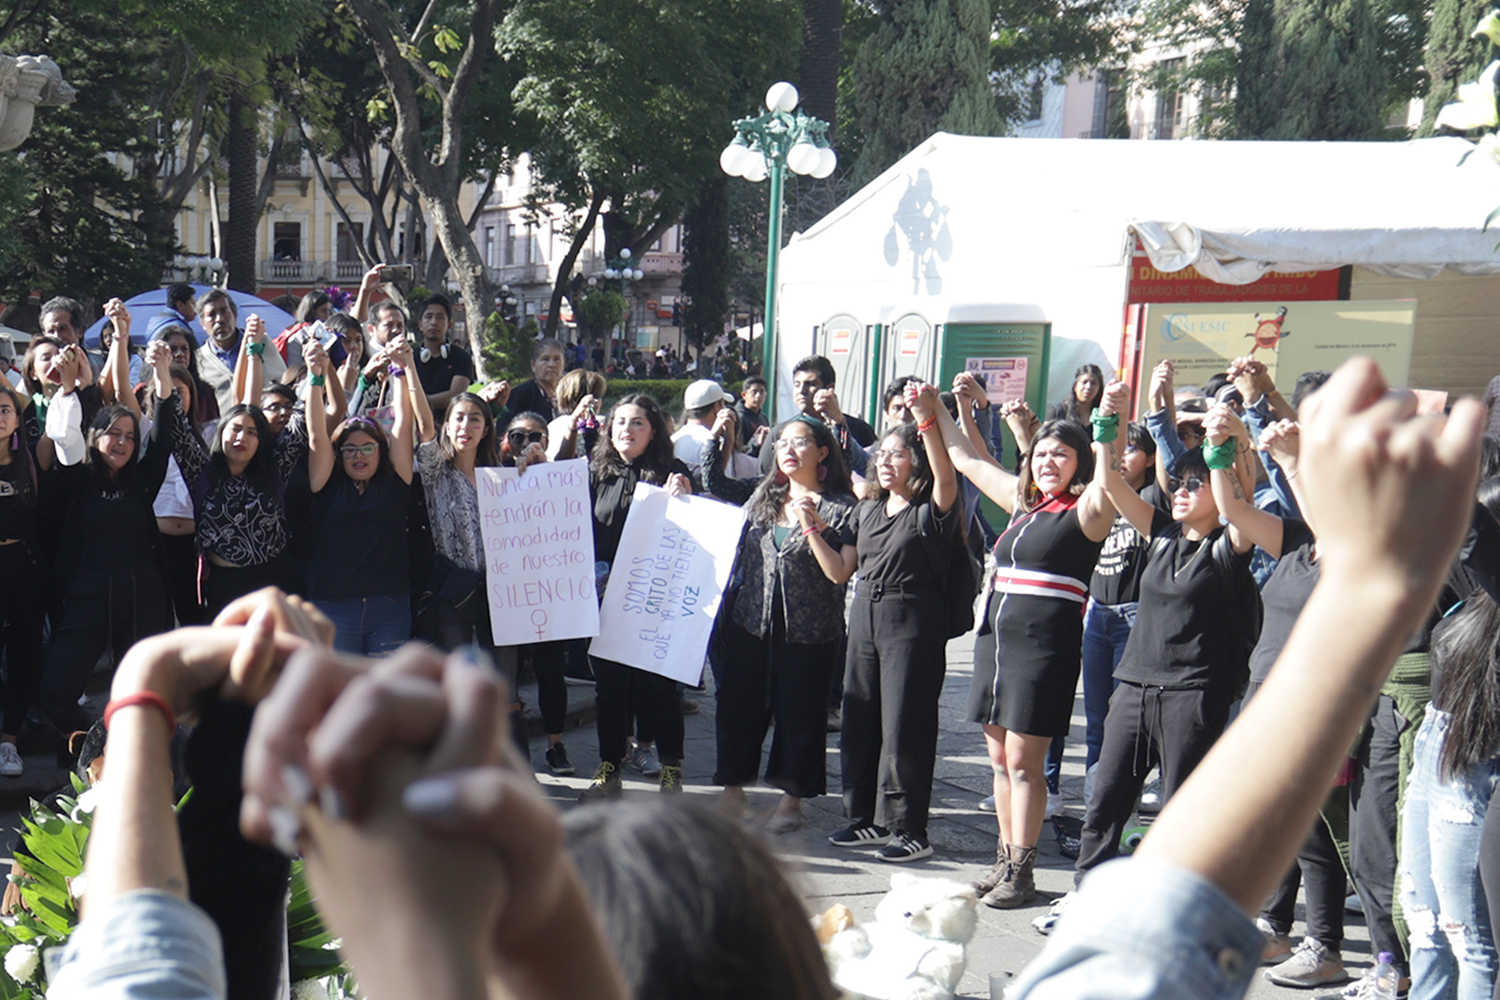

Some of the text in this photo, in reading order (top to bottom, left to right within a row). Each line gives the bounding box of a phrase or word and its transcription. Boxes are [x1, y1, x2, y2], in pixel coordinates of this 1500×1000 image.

[482, 465, 583, 498] Nunca más
[484, 497, 583, 528] tendrán la
[487, 525, 581, 552] comodidad
[491, 549, 586, 575] de nuestro
[493, 575, 593, 609] SILENCIO
[622, 556, 655, 615] SOMOS
[639, 526, 681, 642] EL GRITO DE LAS
[681, 585, 701, 617] VOZ
[653, 633, 671, 660] QUE
[668, 586, 683, 604] NO
